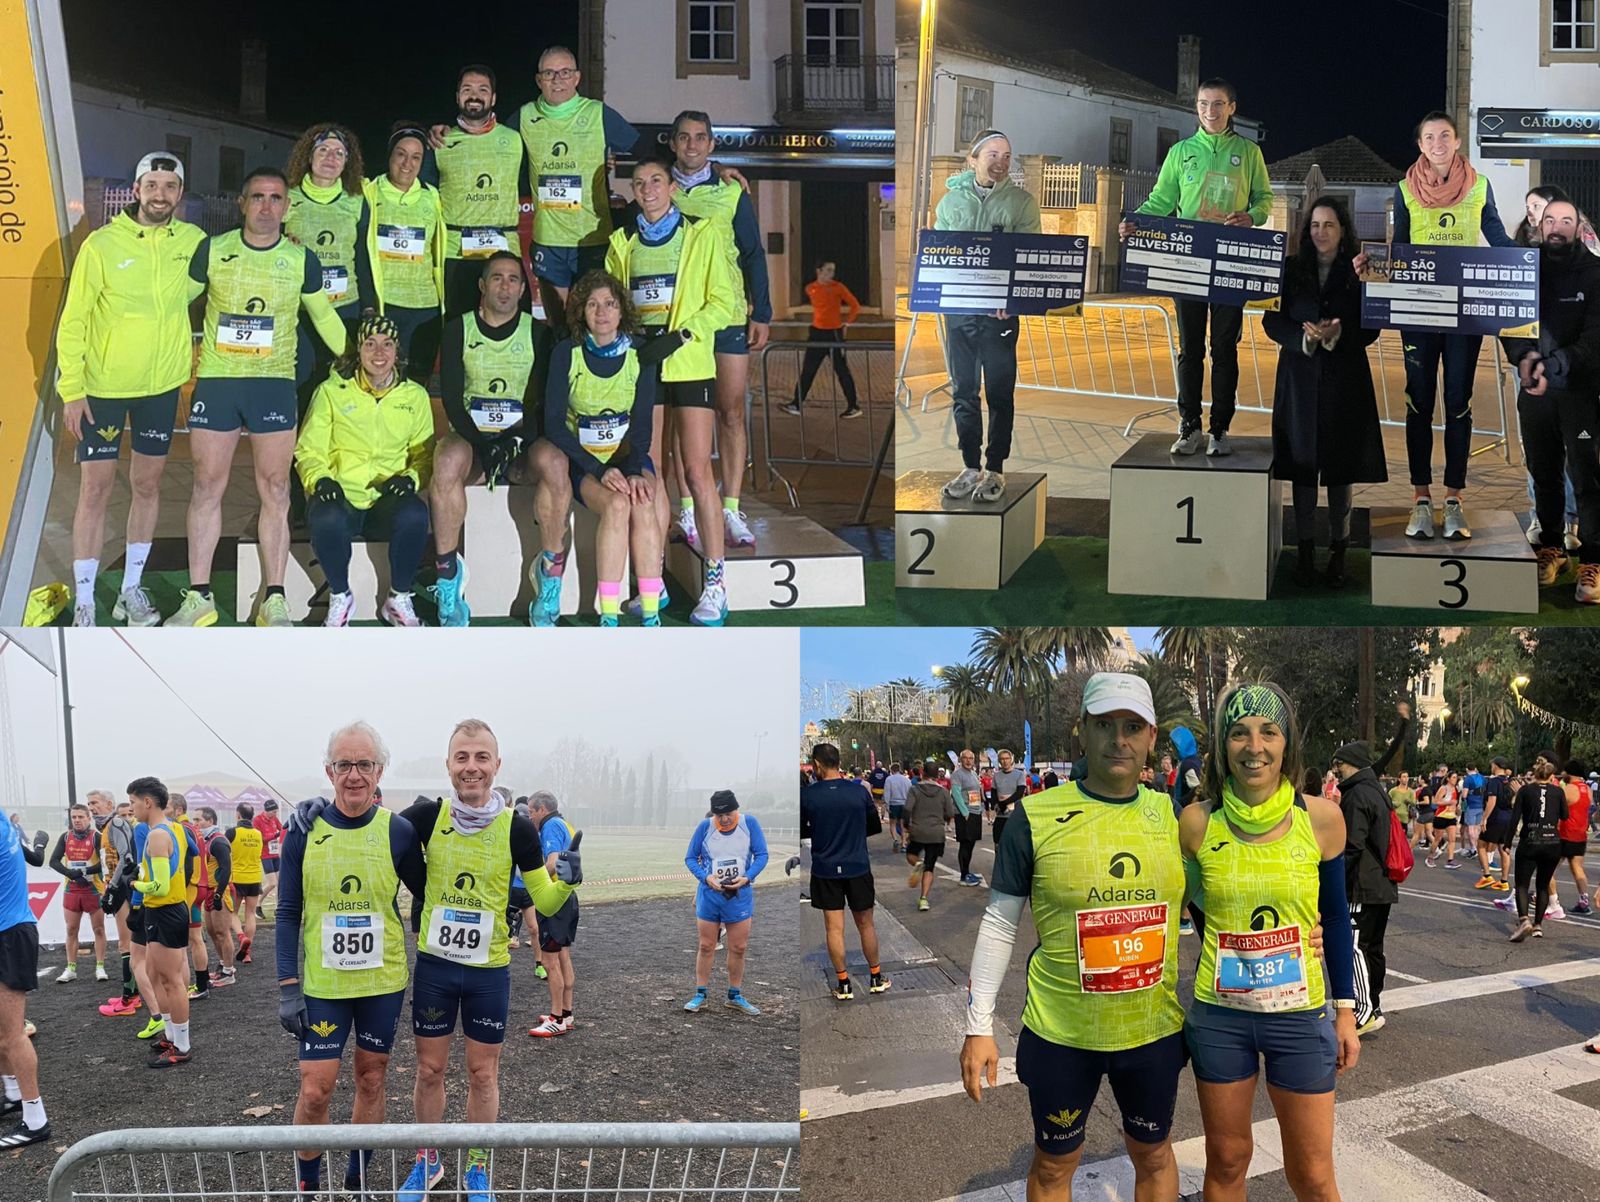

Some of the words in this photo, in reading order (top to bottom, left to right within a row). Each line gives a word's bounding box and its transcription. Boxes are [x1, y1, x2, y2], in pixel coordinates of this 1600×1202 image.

[1520, 116, 1594, 128] CARDOSO
[739, 133, 837, 149] JOALHEIROS
[542, 161, 576, 170] Adarsa
[466, 193, 499, 202] Adarsa
[549, 188, 567, 197] 162
[1, 211, 26, 244] de
[1134, 230, 1167, 240] orrida
[1170, 231, 1193, 243] SÃO
[1428, 232, 1463, 241] Adarsa
[393, 240, 409, 249] 60
[923, 245, 963, 255] corrida
[966, 245, 991, 255] SÃO
[1127, 237, 1192, 254] SILVESTRE
[318, 250, 340, 260] arsa
[920, 255, 990, 266] SILVESTRE
[1229, 264, 1266, 273] Mogadouro
[1411, 259, 1436, 270] SÃO
[323, 280, 332, 289] 8
[645, 289, 659, 300] 53
[1478, 289, 1519, 298] Mogadouro
[235, 330, 252, 341] 57
[488, 413, 504, 423] 59
[597, 430, 613, 440] 56
[1175, 496, 1203, 544] 1
[908, 528, 936, 576] 2
[768, 560, 799, 608] 3
[1437, 560, 1470, 609] 3
[440, 892, 482, 908] Adarsa
[1087, 886, 1156, 903] Adarsa
[328, 900, 370, 911] Adarsa
[1104, 907, 1162, 925] GENERALI
[438, 925, 480, 949] 849
[1237, 930, 1294, 949] GENERALI
[332, 932, 374, 955] 850
[1112, 937, 1144, 955] 196
[1236, 959, 1285, 978] 11387
